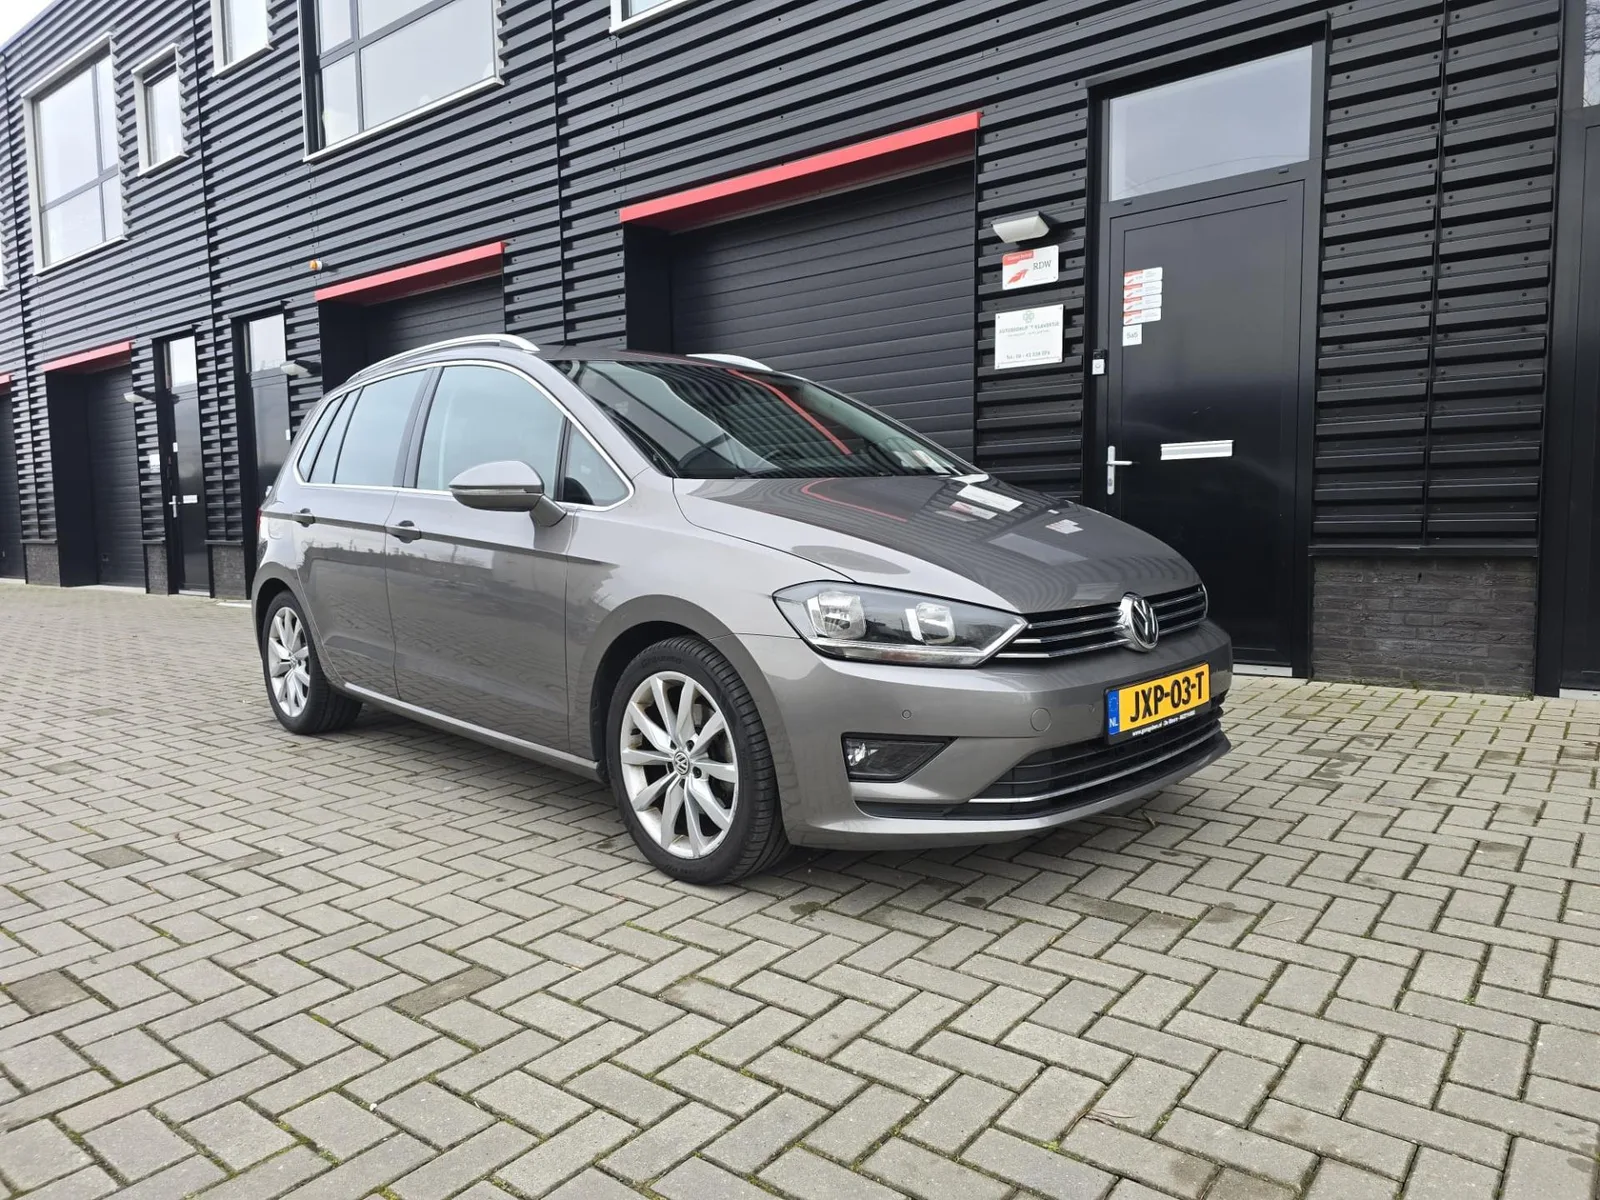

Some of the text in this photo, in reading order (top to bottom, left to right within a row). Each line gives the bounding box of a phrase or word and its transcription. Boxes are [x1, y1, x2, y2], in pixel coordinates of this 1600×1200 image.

[1033, 260, 1052, 270] RDW
[1130, 671, 1204, 723] JXP-03-T
[1108, 717, 1119, 728] NL
